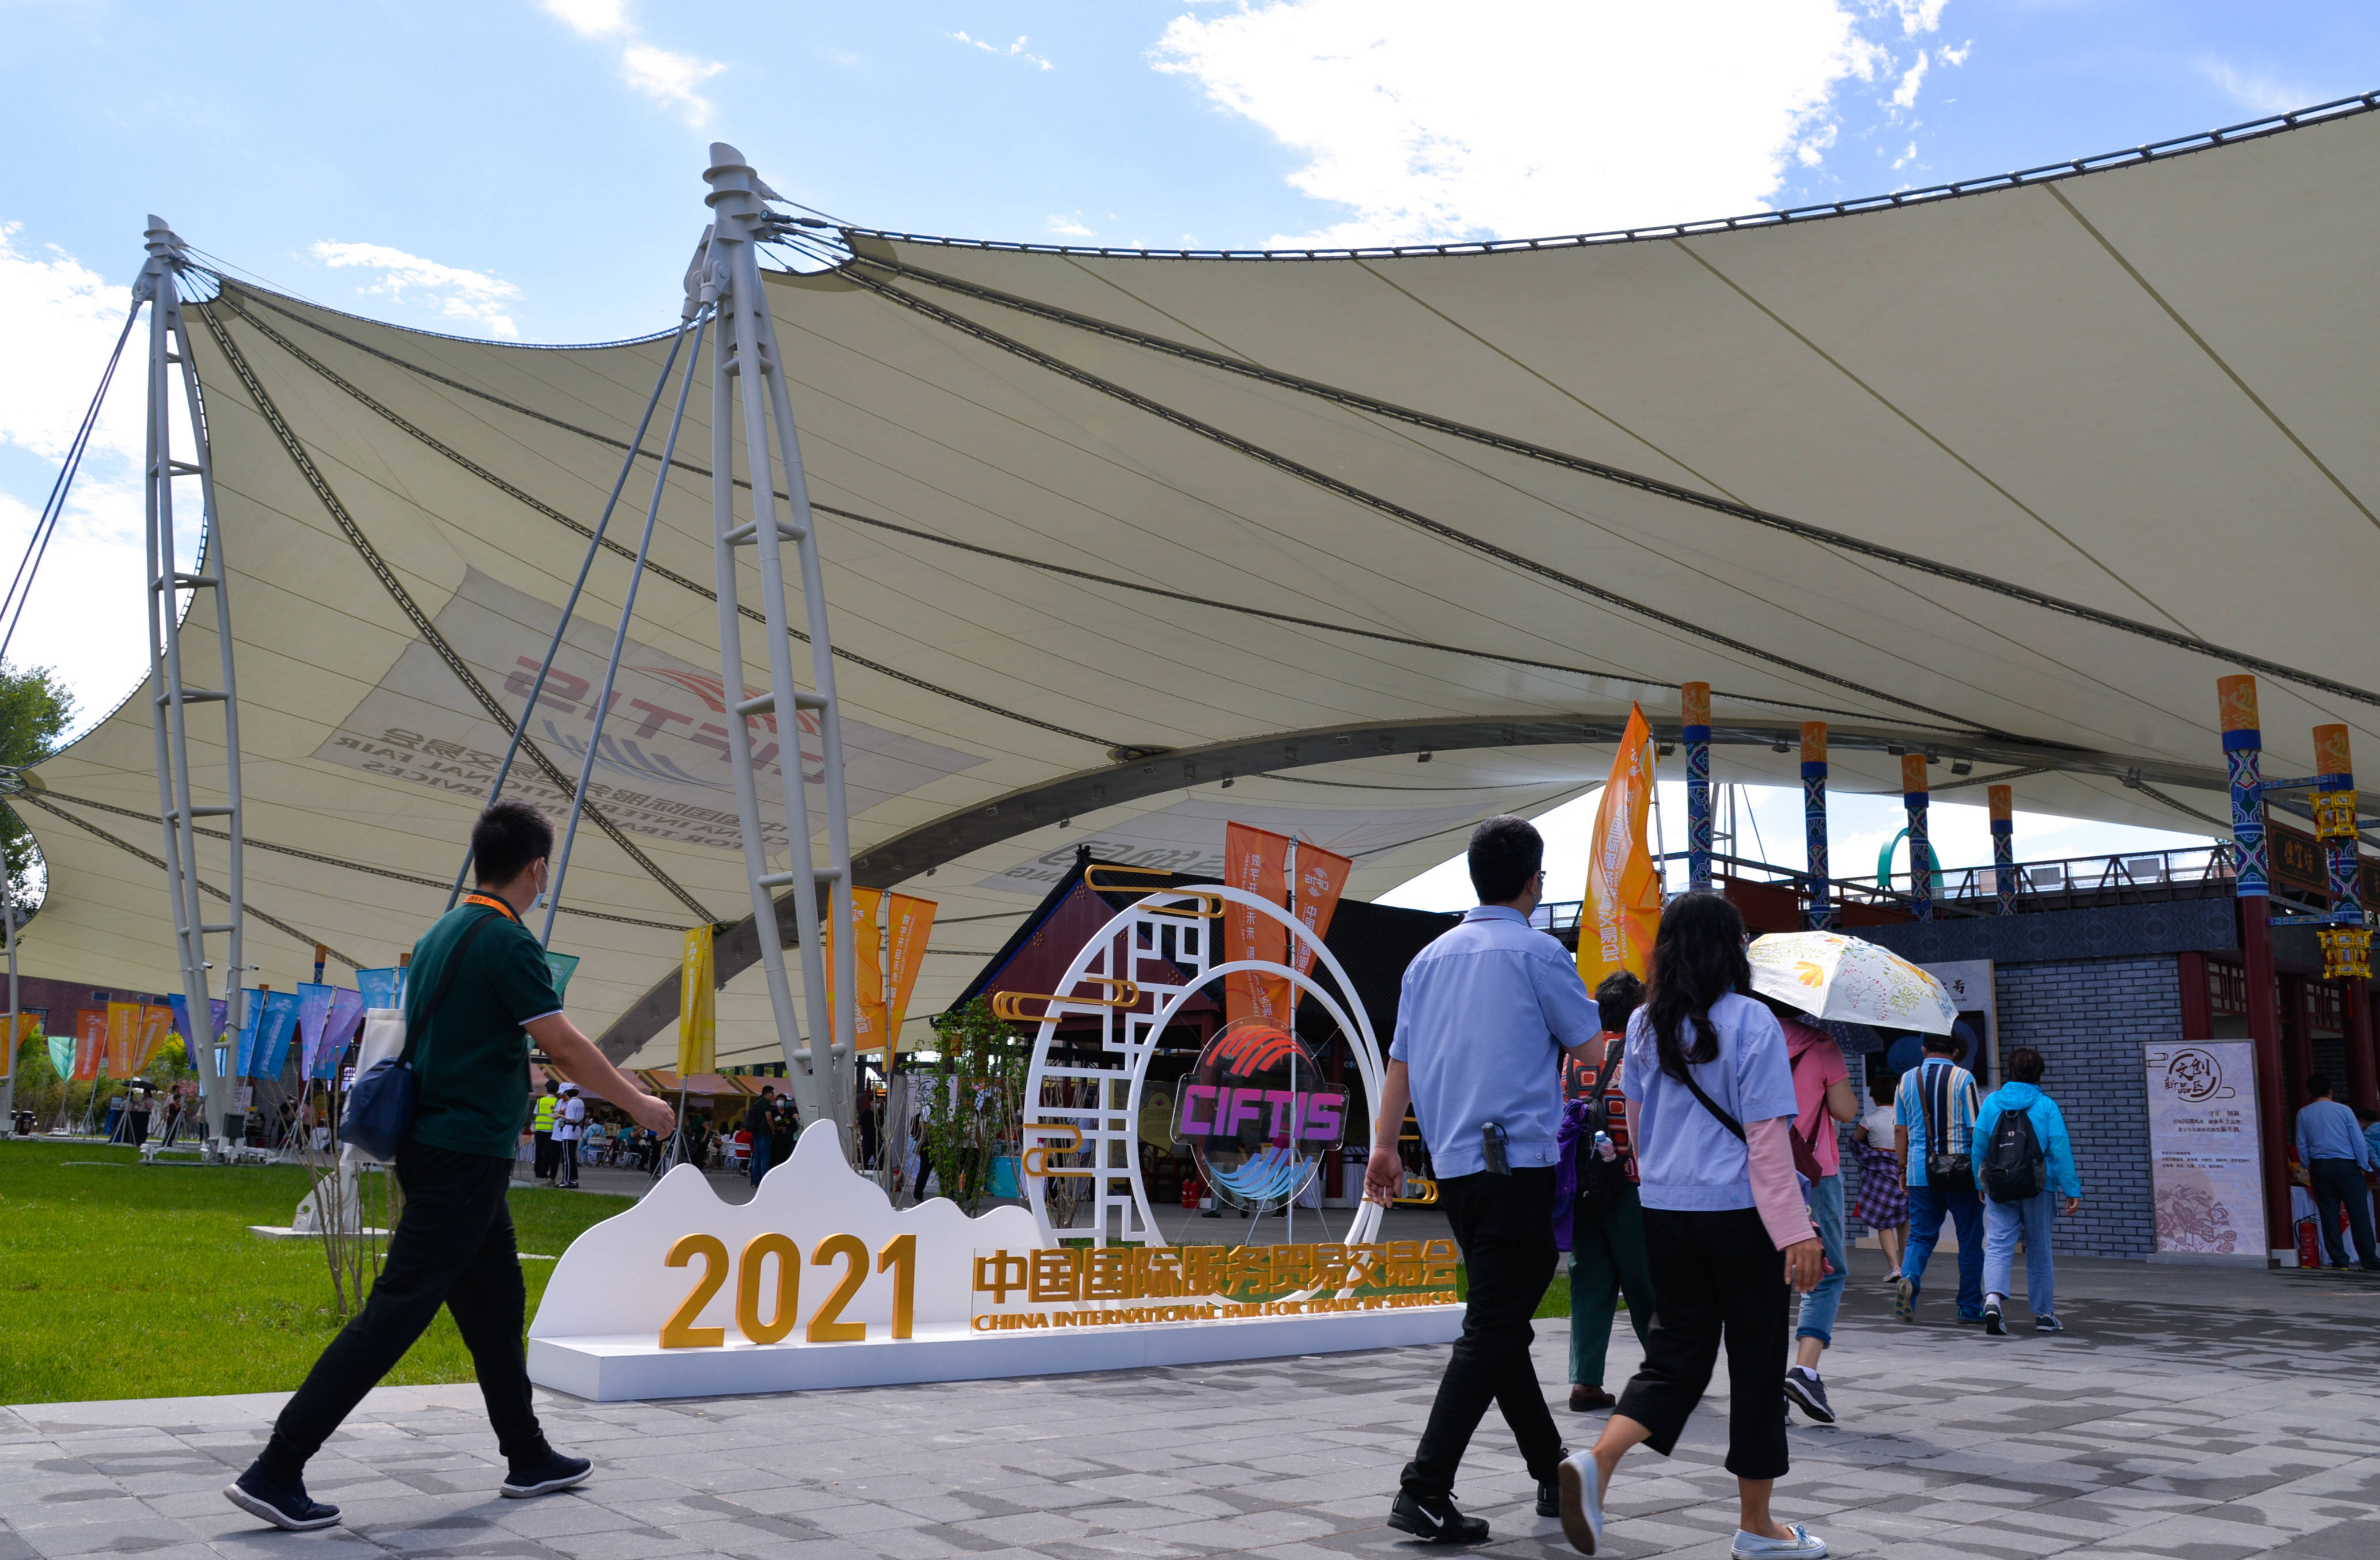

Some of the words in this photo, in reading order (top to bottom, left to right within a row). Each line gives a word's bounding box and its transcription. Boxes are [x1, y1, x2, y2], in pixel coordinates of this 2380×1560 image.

[2164, 1076, 2204, 1094] 新品区
[2175, 1058, 2210, 1081] 文创
[1180, 1084, 1343, 1140] CIFTIS
[659, 1232, 917, 1349] 2021
[973, 1239, 1458, 1304] 中国国际服务贸易交易会
[972, 1312, 1049, 1331] CHINA
[1052, 1304, 1219, 1327] INTERNATIONAL
[1222, 1302, 1263, 1319] FAIR
[1265, 1300, 1303, 1316] FOR
[1305, 1296, 1361, 1314] TRADE
[1363, 1295, 1383, 1310] IN
[1385, 1290, 1459, 1309] SERVICES
